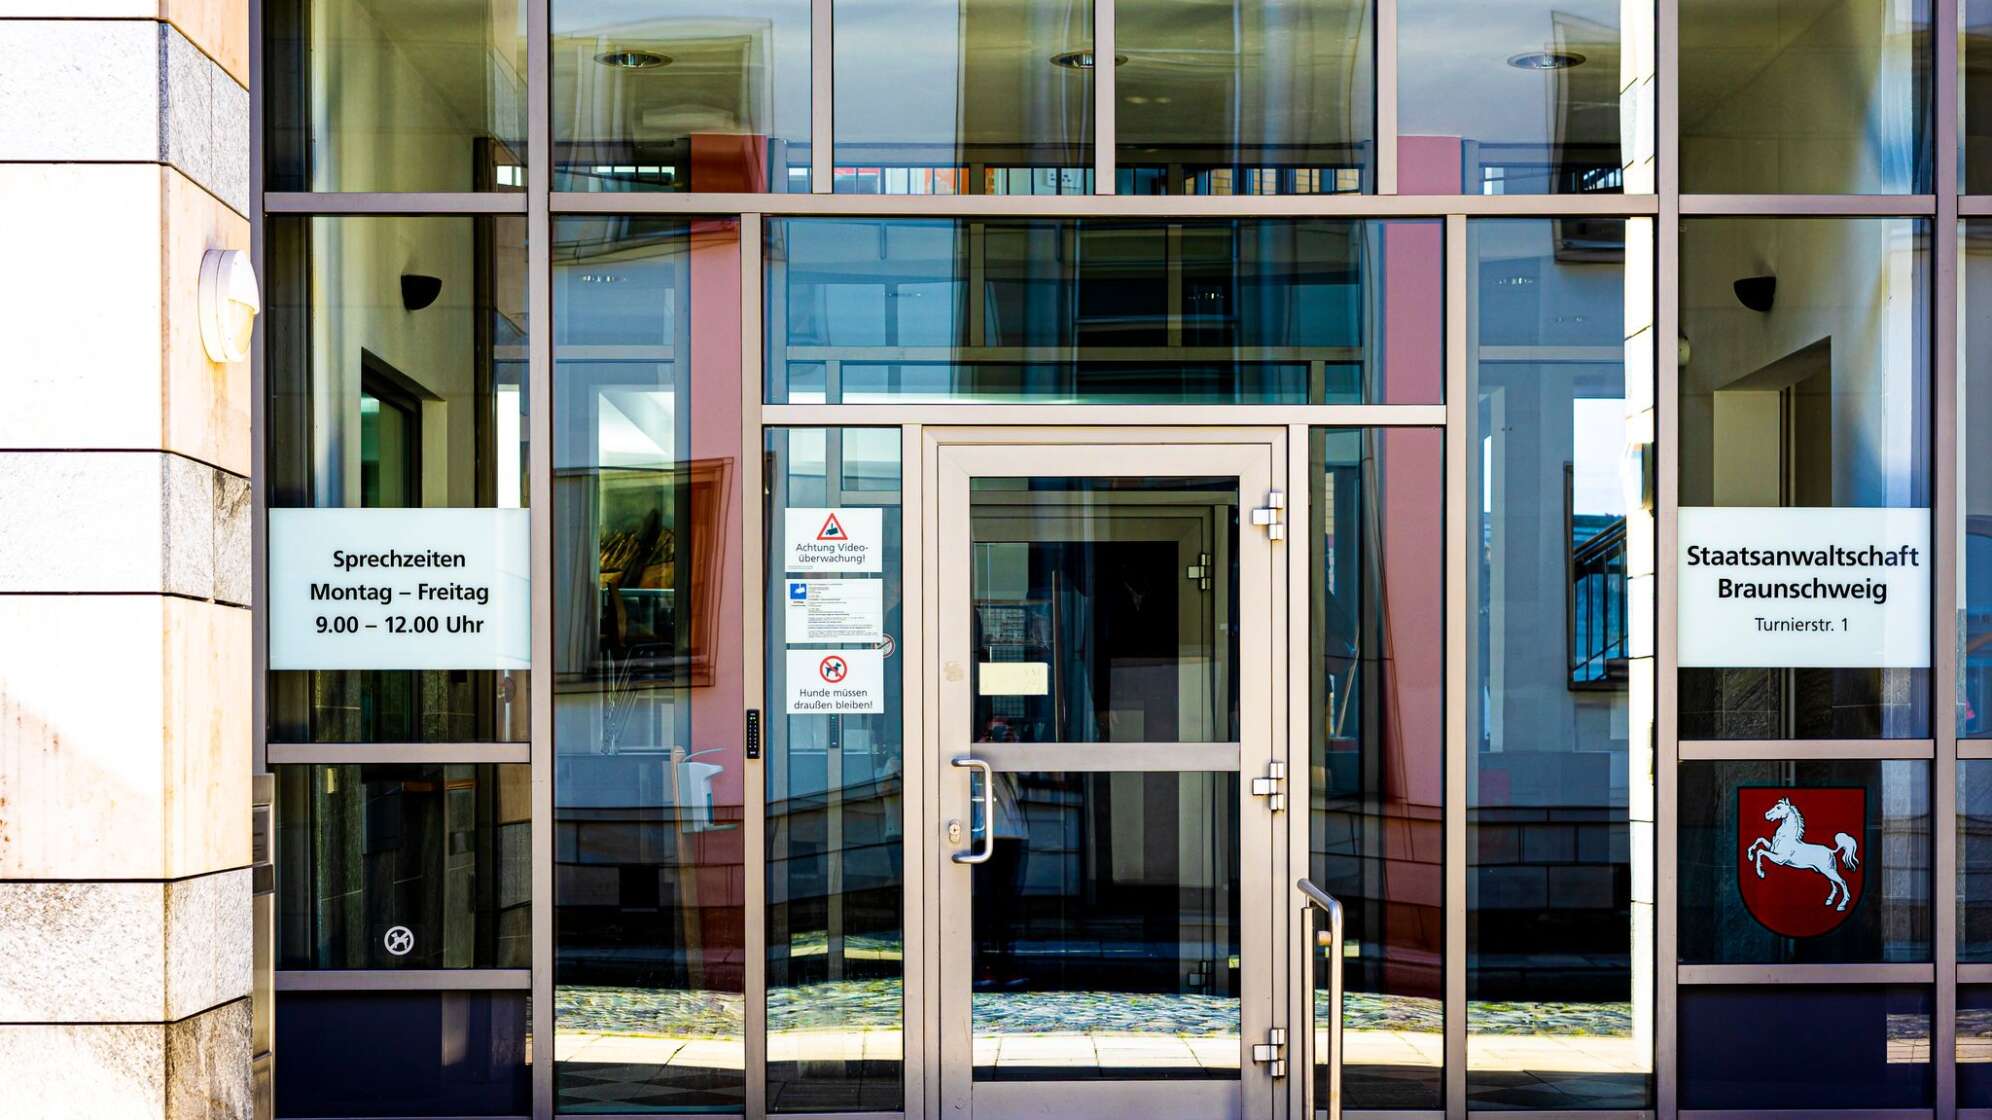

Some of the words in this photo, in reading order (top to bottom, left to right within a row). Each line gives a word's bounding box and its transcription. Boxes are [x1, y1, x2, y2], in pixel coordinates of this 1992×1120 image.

[795, 542, 835, 554] Achtung
[837, 542, 869, 552] Video-
[1687, 544, 1920, 567] Staatsanwaltschaft
[333, 549, 466, 572] Sprechzeiten
[798, 553, 866, 565] überwachung!
[310, 582, 392, 606] Montag
[418, 582, 489, 606] Freitag
[1718, 577, 1888, 605] Braunschweig
[315, 615, 359, 634] 9.00
[384, 615, 439, 634] 12.00
[446, 614, 485, 634] Uhr
[1754, 616, 1834, 632] Turnierstr.
[1841, 617, 1849, 632] 1
[799, 688, 831, 698] Hunde
[833, 688, 868, 698] müssen
[794, 700, 833, 710] draußen
[835, 700, 873, 710] bleiben!
